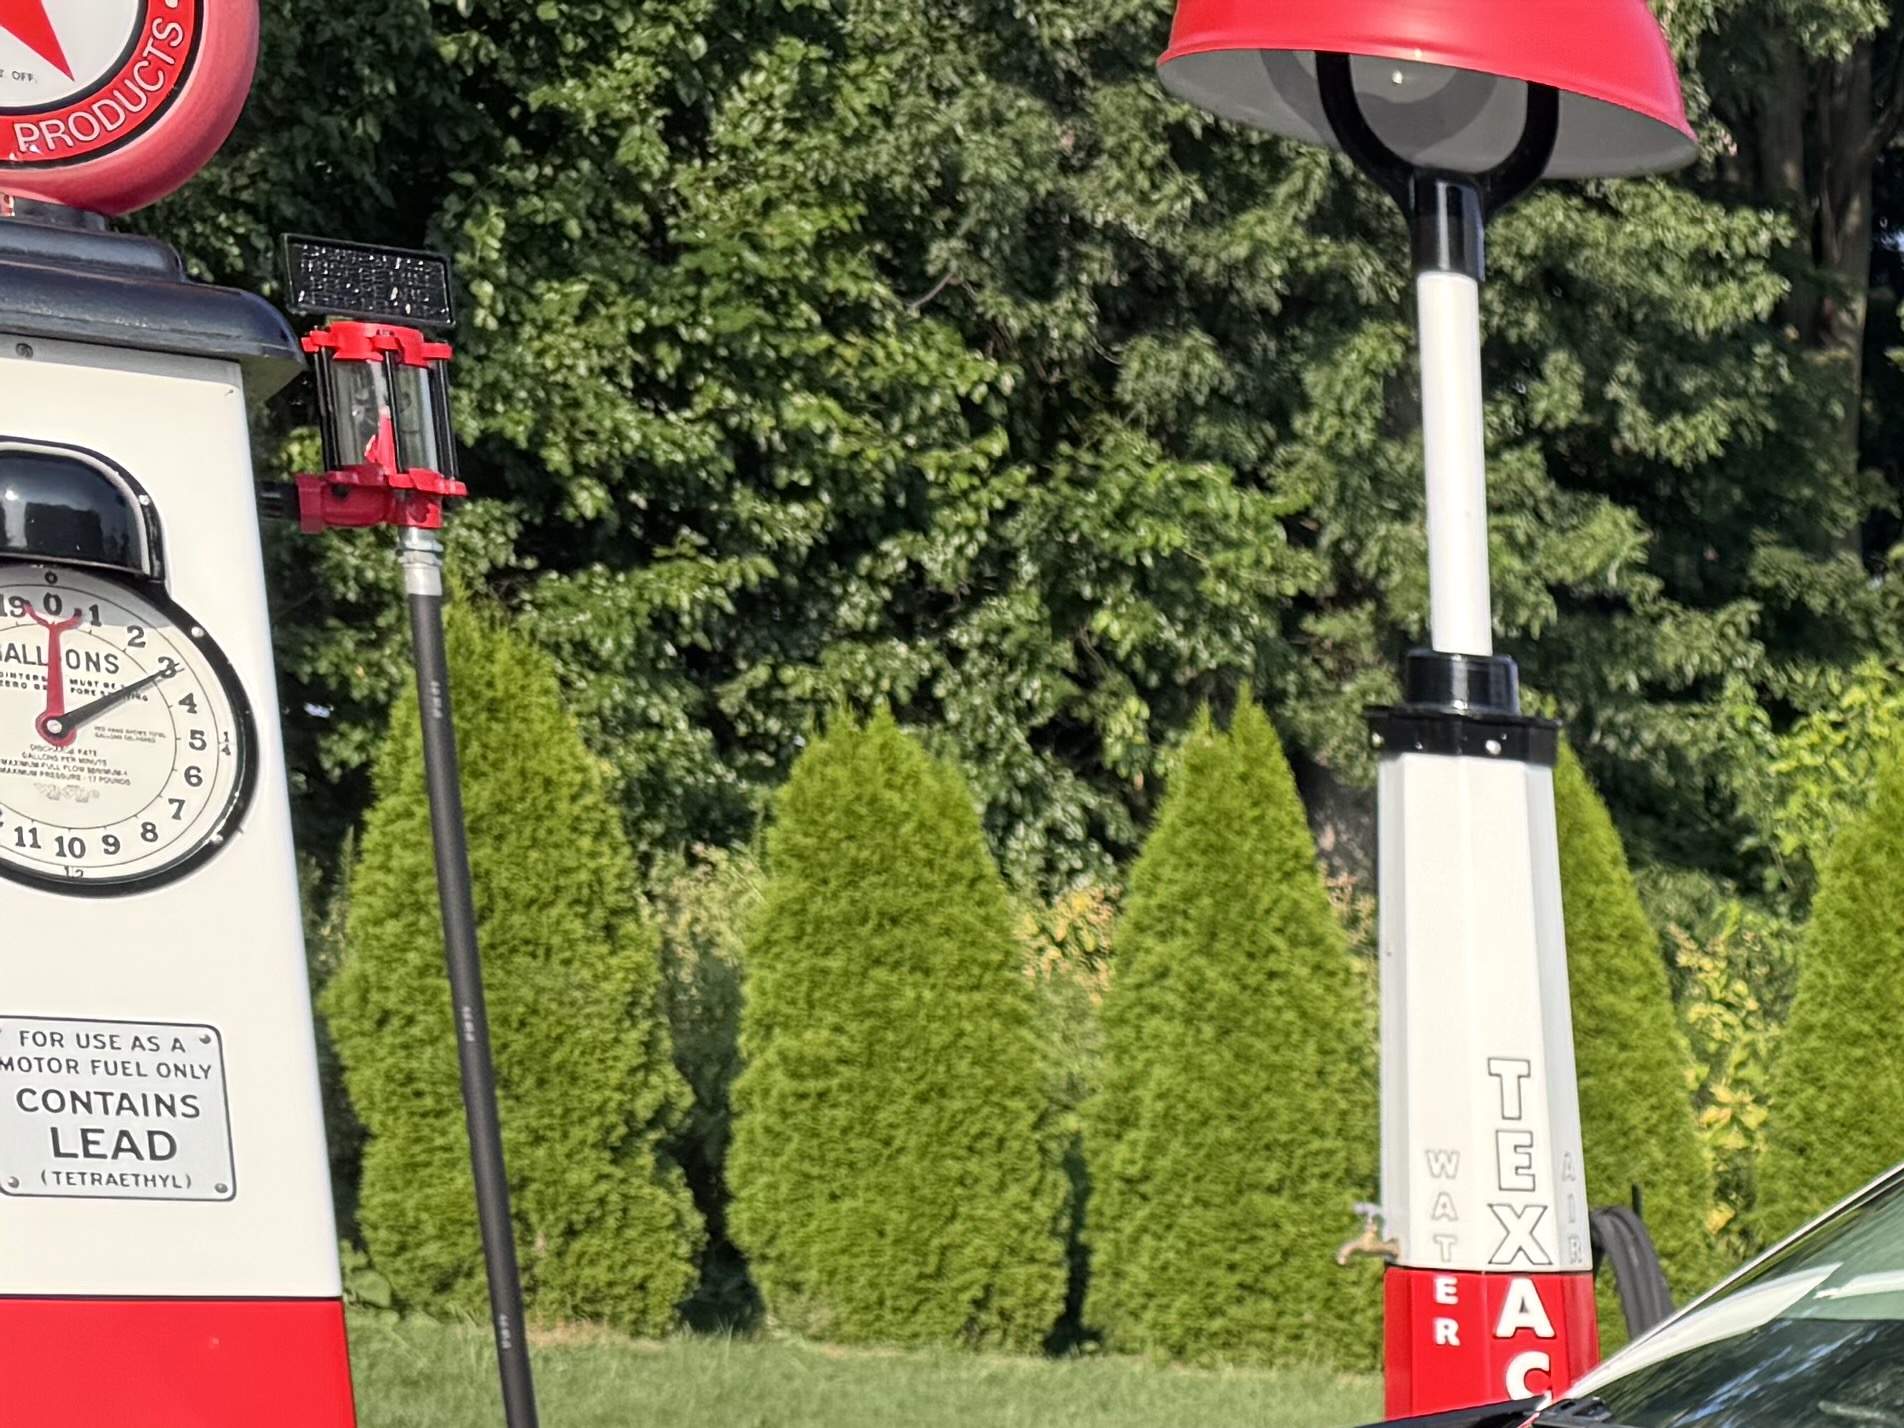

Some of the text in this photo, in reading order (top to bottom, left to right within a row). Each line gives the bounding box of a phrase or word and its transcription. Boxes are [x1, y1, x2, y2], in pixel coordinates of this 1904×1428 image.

[13, 17, 184, 153] PRODUCTS
[43, 592, 62, 616] 0
[89, 604, 102, 627] 1
[126, 625, 146, 648] 2
[158, 656, 178, 679] 3
[178, 693, 198, 714] 4
[189, 729, 207, 751] 5
[184, 765, 203, 787] 6
[168, 798, 186, 821] 7
[14, 826, 41, 849] 11
[140, 822, 158, 843] 8
[55, 836, 86, 859] 10
[101, 834, 121, 855] 9
[19, 1030, 187, 1053] FOR USE AS A
[0, 1056, 212, 1080] MOTOR FUEL ONLY
[16, 1087, 200, 1119] CONTAINS
[50, 1126, 177, 1161] LEAD
[40, 1169, 192, 1189] (TETRAETHYL)
